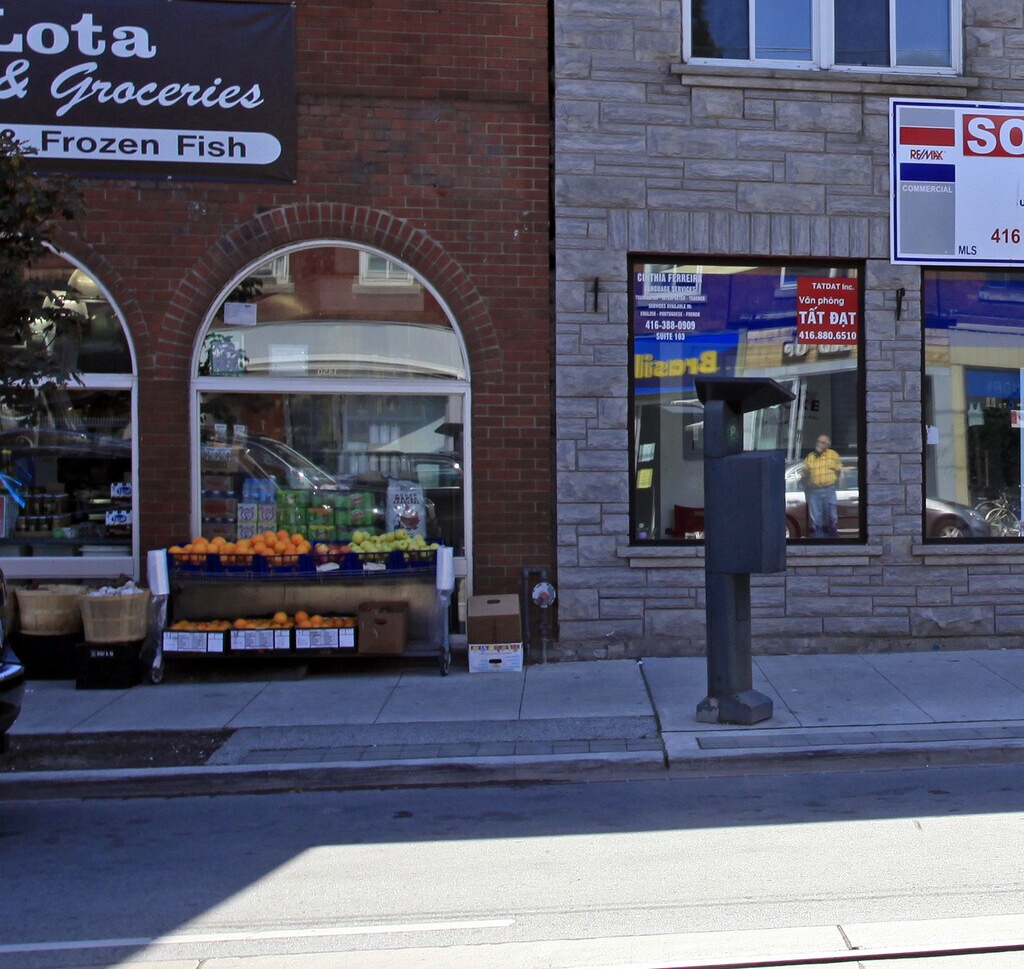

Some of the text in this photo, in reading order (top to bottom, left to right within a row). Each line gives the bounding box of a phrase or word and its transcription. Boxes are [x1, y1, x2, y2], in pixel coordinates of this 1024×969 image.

[0, 59, 265, 117] & Groceries
[41, 130, 159, 156] Frozen
[177, 134, 247, 158] Fish
[910, 149, 944, 160] RE/MAX
[902, 184, 953, 194] COMMERCIAL
[990, 228, 1020, 244] 416
[958, 244, 977, 256] MLS
[645, 320, 696, 330] 416-388-0909
[799, 330, 857, 340] 416.880.6510
